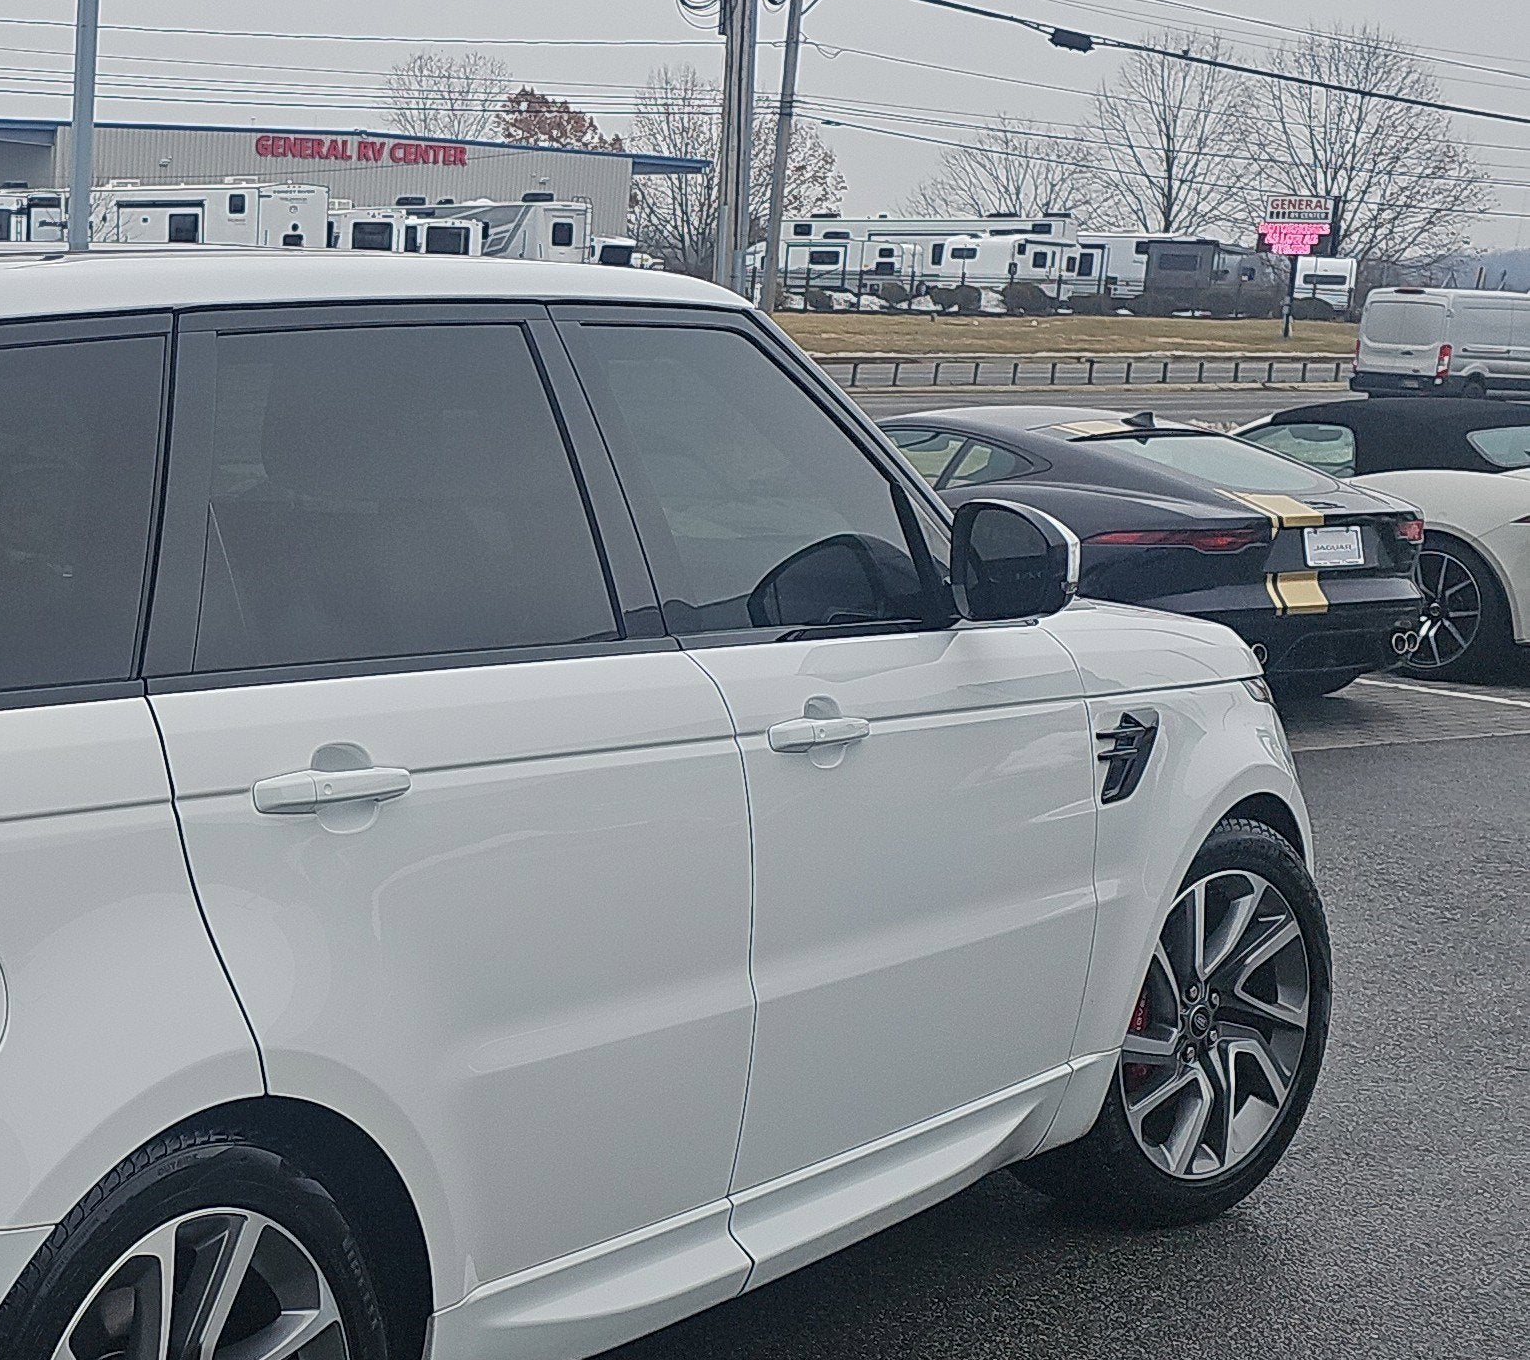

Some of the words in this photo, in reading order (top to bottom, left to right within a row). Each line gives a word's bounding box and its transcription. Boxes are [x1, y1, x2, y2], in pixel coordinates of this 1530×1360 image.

[255, 136, 352, 161] GENERAL
[358, 141, 386, 162] RV
[390, 142, 468, 166] CENTER
[1271, 199, 1330, 210] GENERAL
